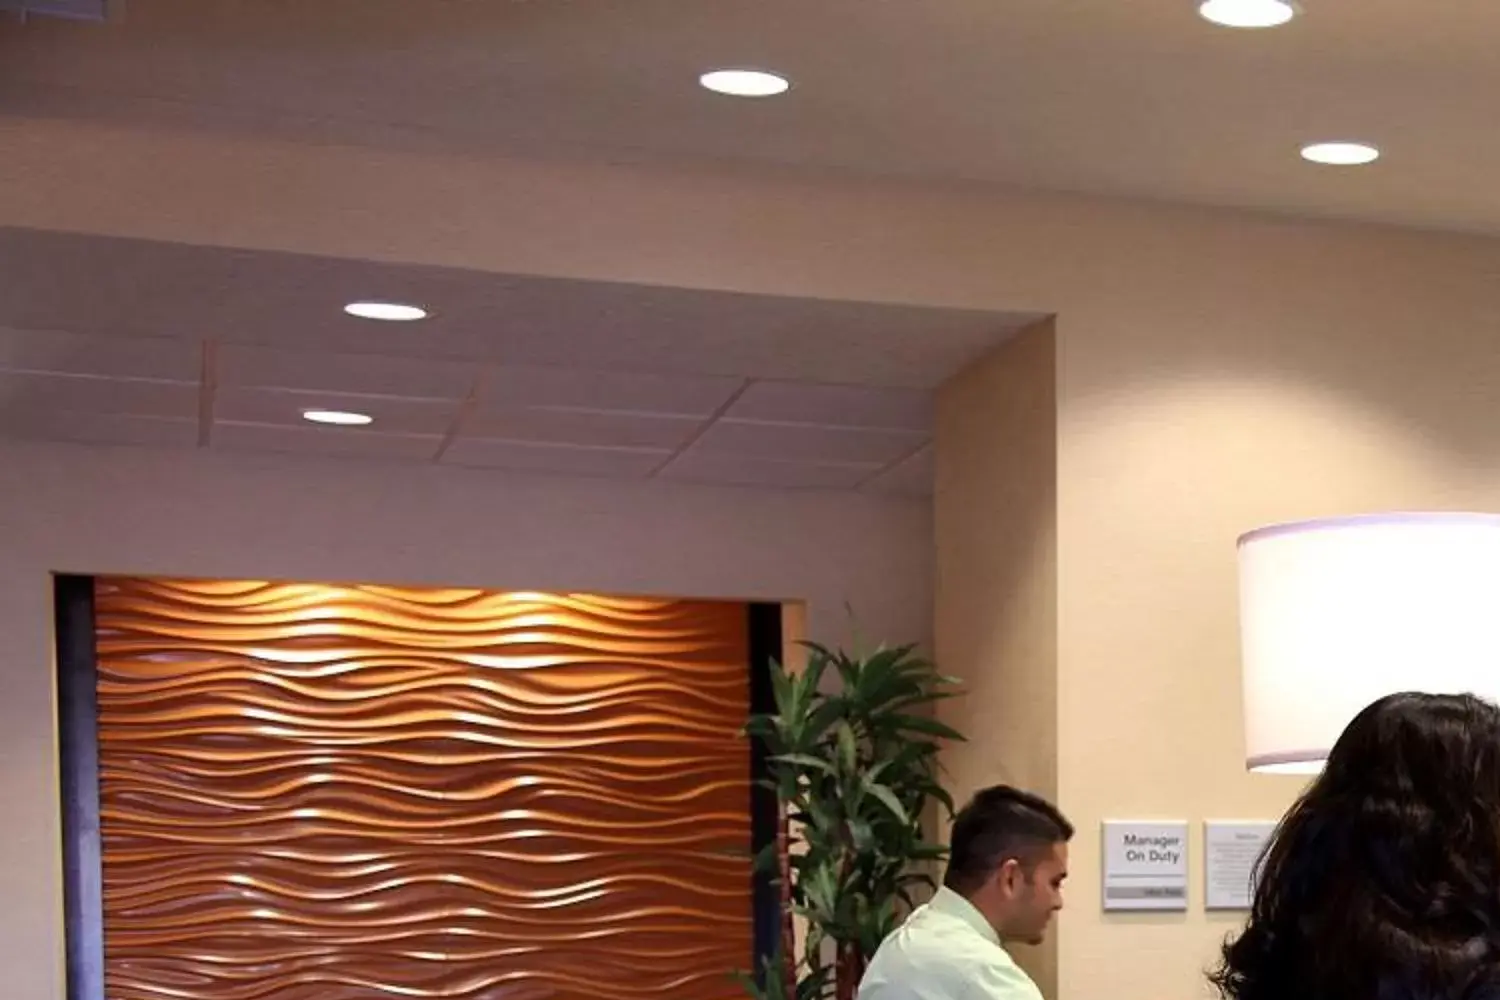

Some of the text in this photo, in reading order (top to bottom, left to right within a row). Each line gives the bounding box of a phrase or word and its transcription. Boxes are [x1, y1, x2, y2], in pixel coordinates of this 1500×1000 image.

[1124, 834, 1179, 848] Manager
[1126, 850, 1180, 864] On Duty
